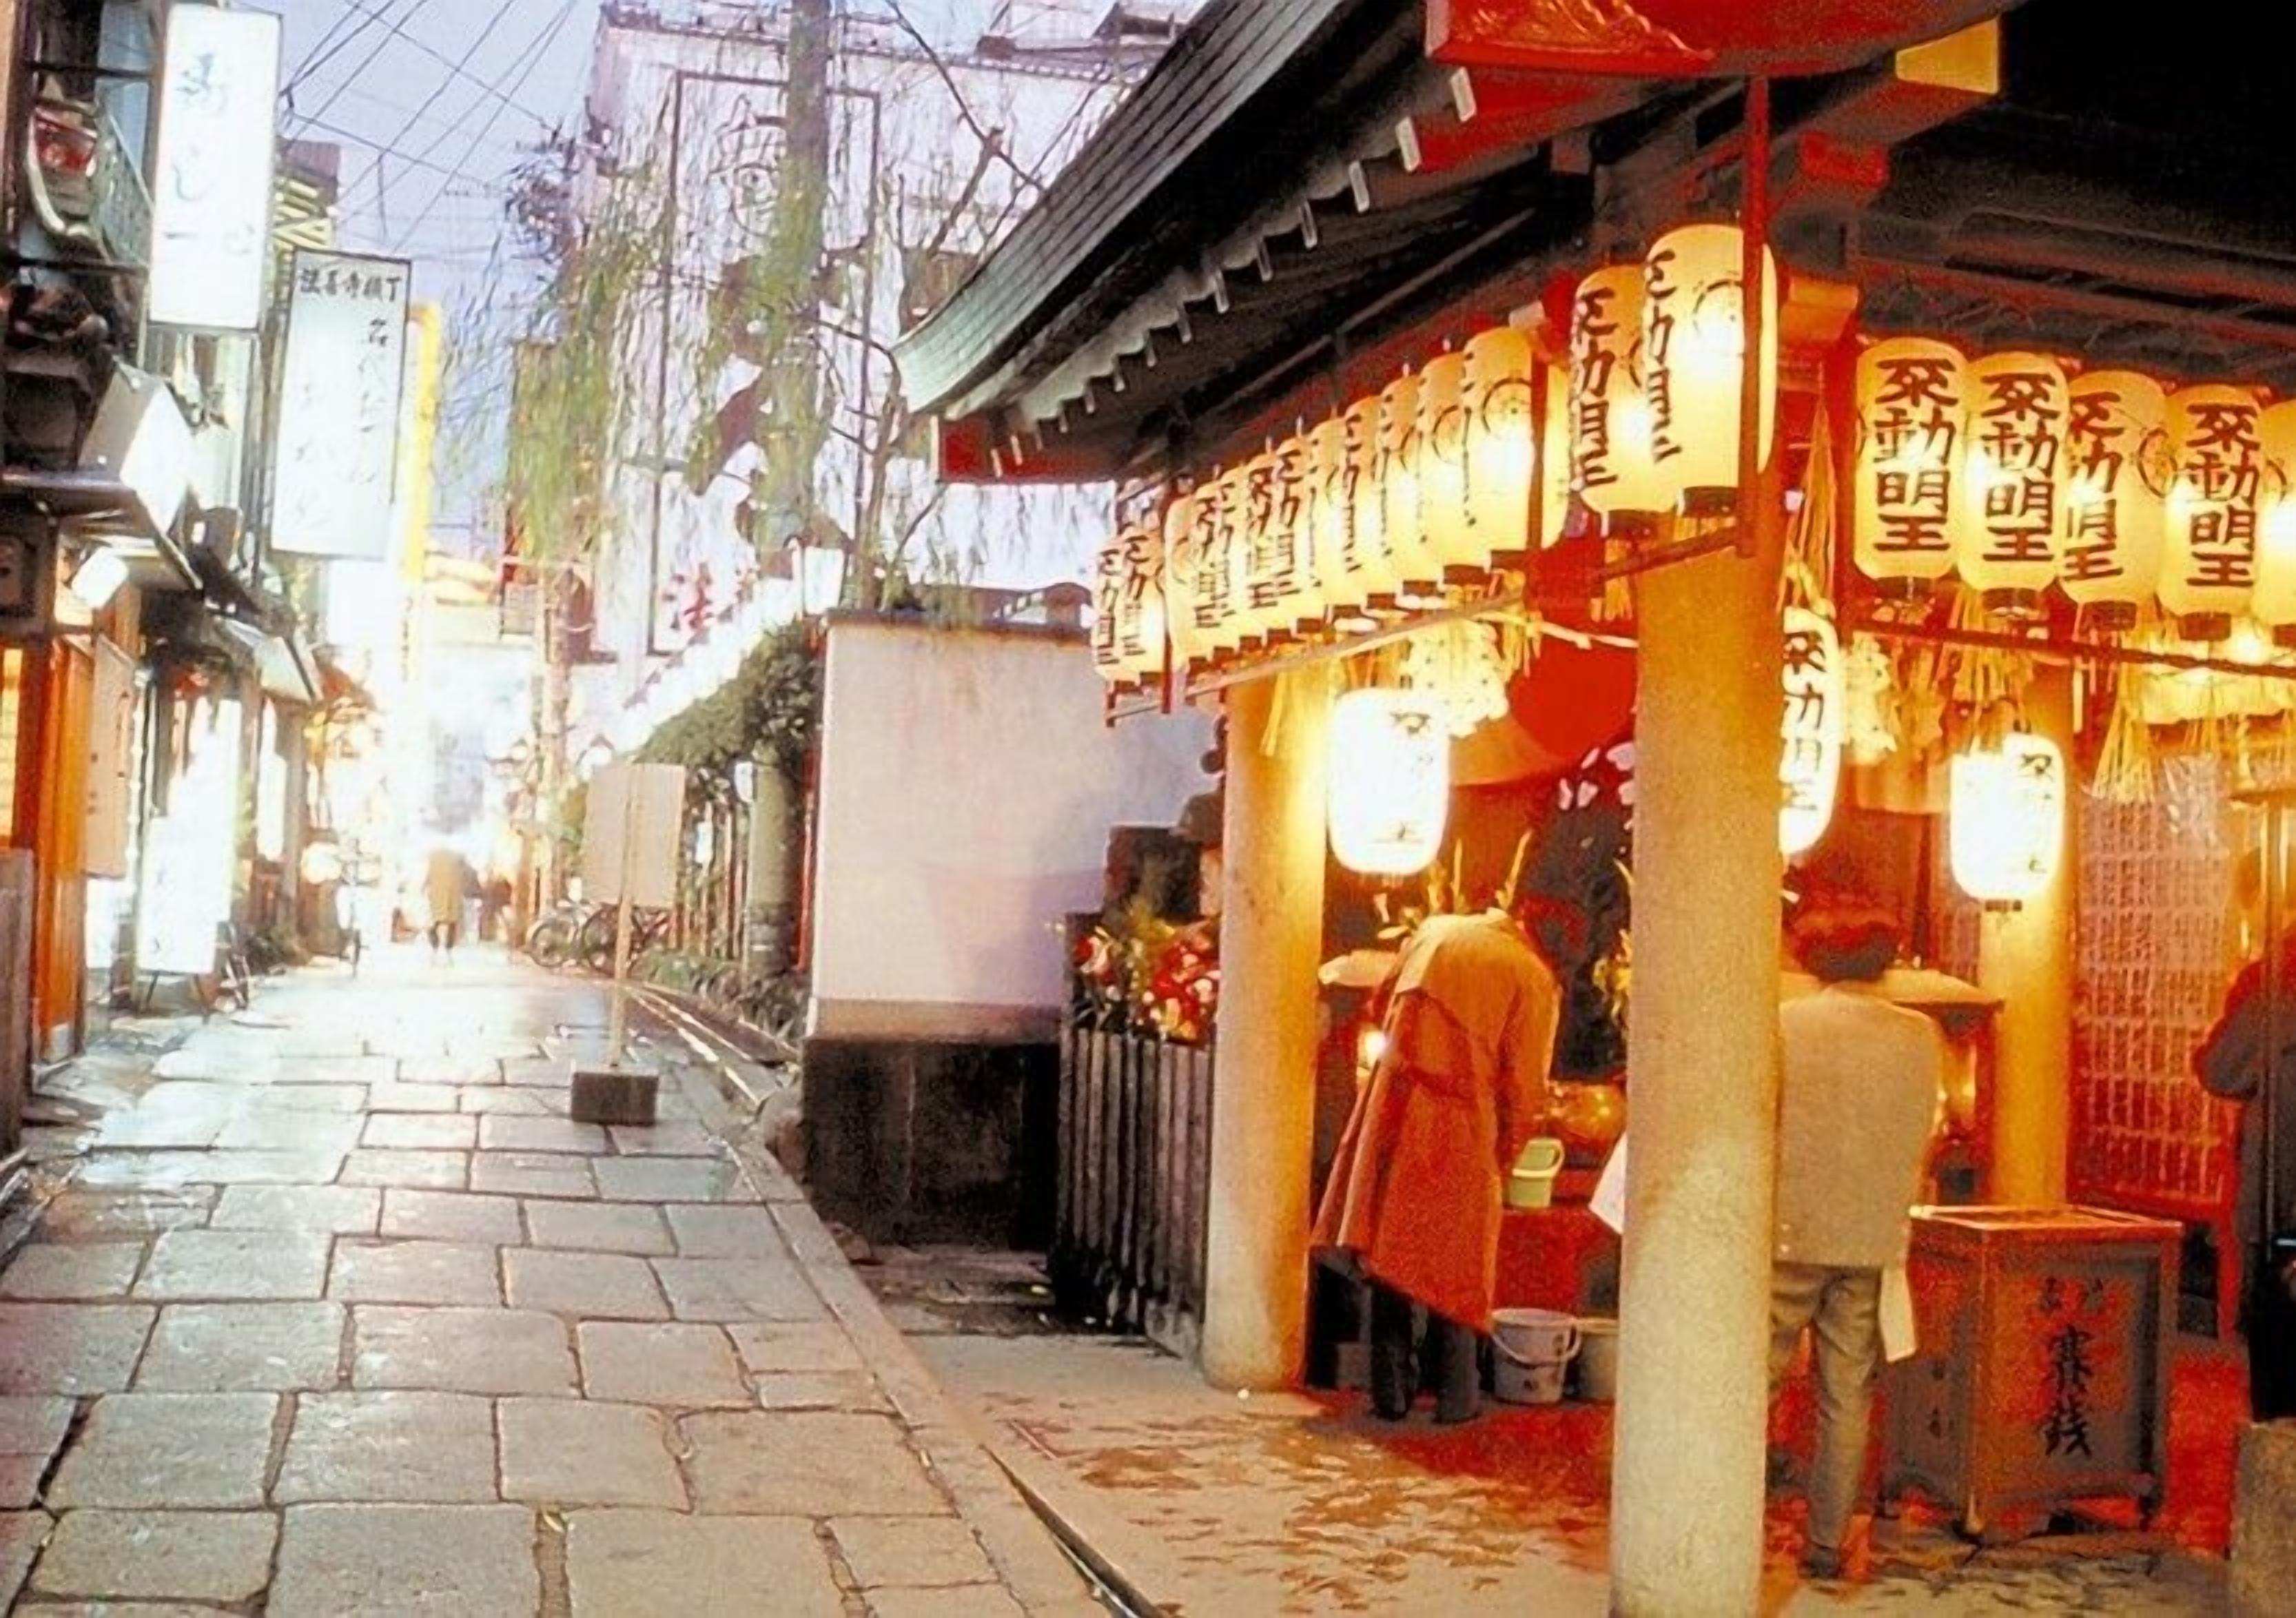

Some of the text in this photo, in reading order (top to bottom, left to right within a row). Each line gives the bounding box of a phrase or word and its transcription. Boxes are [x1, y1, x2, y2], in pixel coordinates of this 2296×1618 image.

[1874, 358, 1958, 551] 不動明王
[1979, 373, 2060, 562] 不動明王
[2184, 404, 2262, 586] 不動明王
